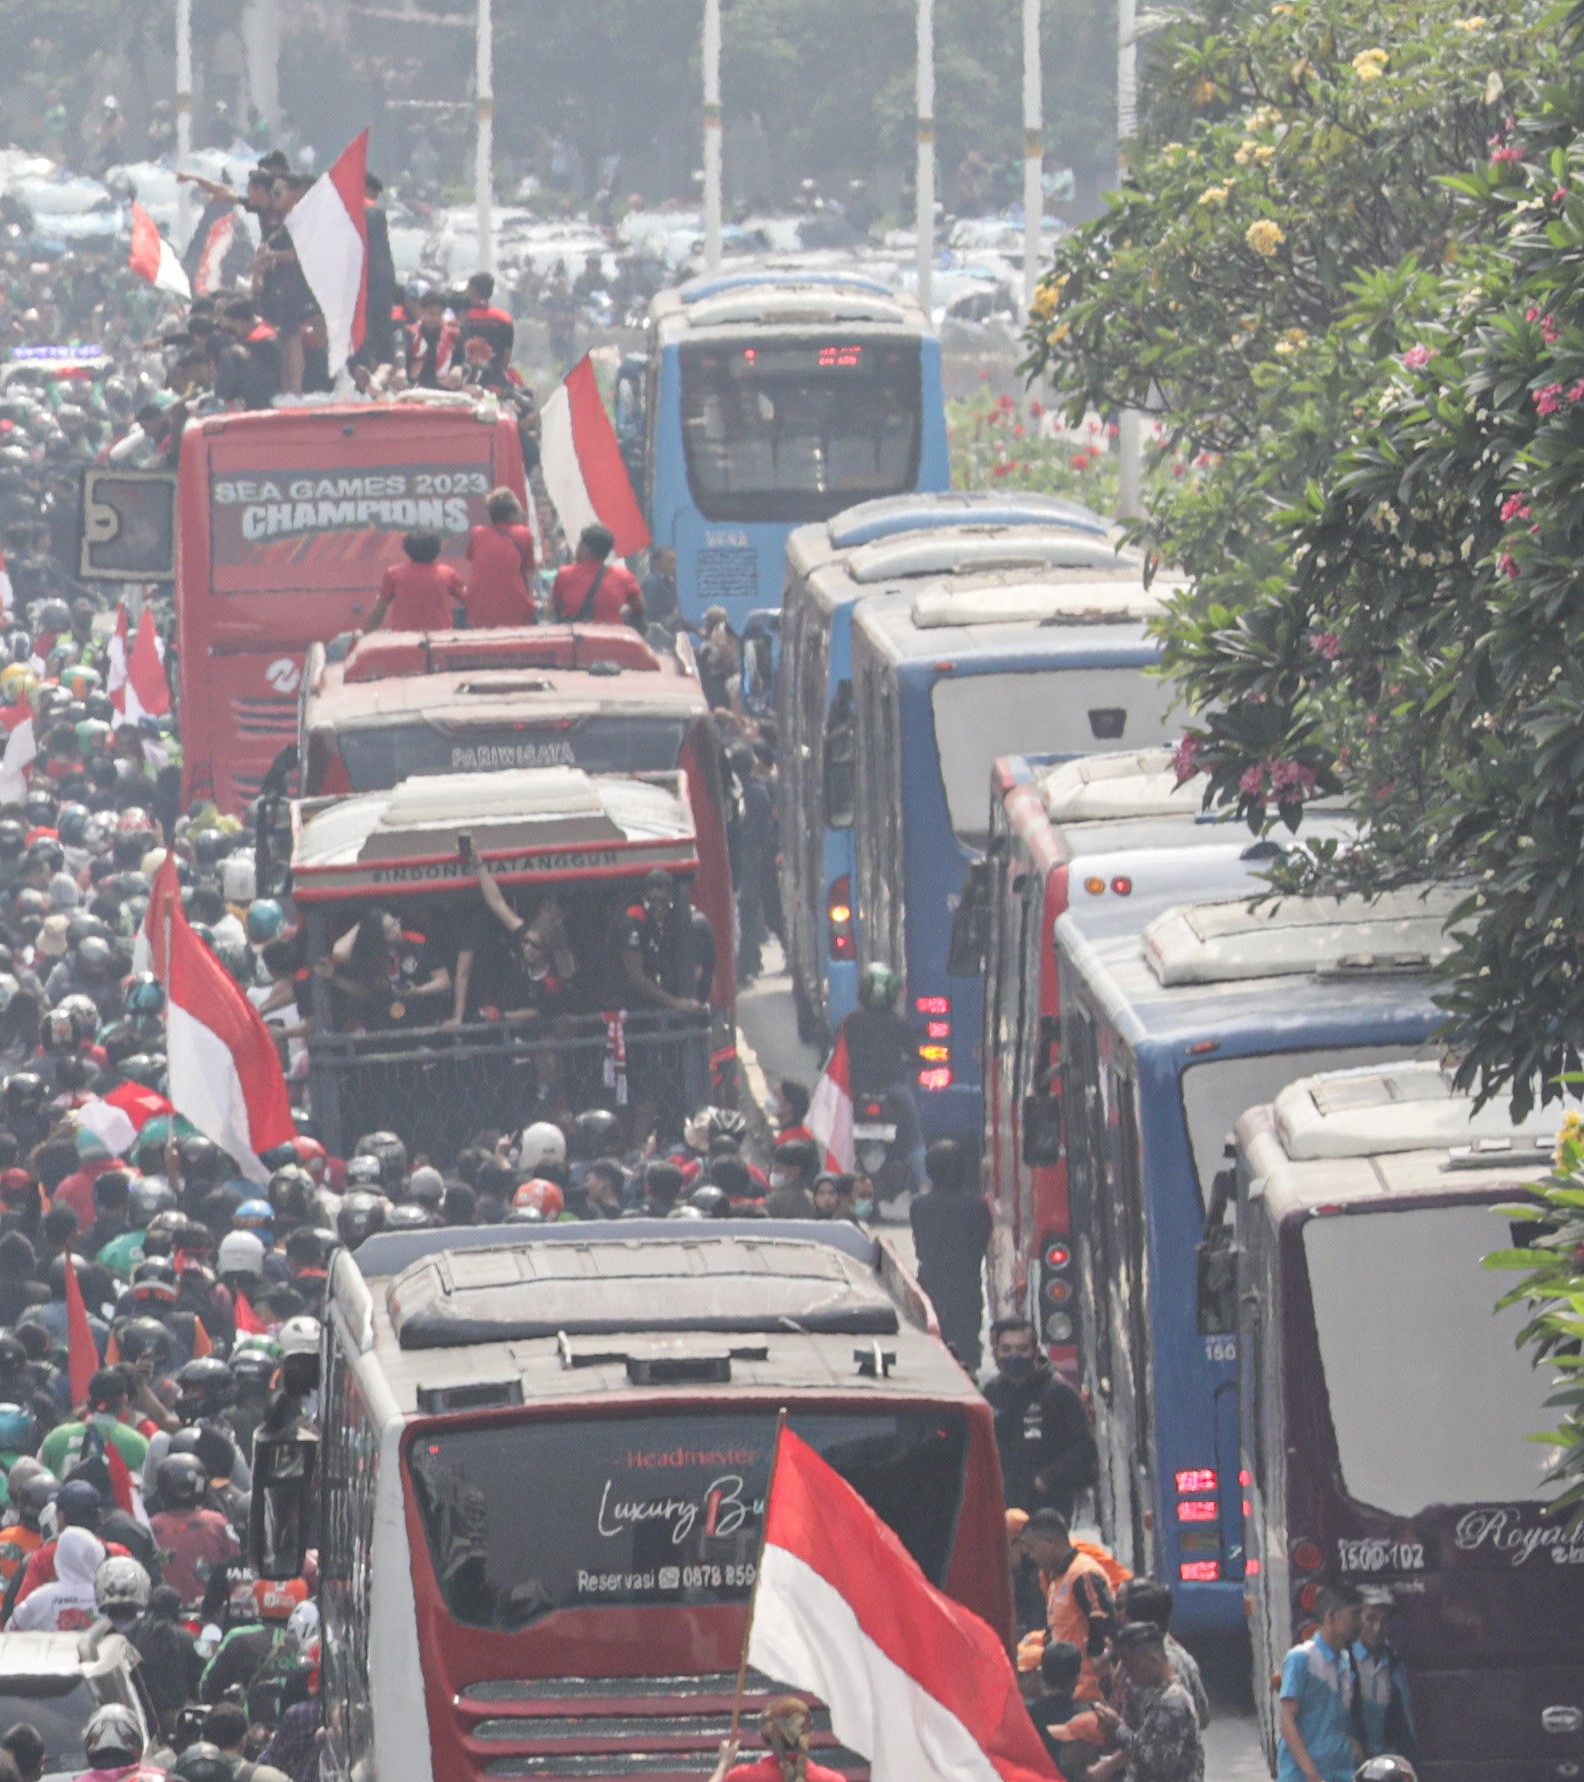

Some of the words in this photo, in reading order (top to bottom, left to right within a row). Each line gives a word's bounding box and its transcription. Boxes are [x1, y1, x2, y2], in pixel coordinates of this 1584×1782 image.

[214, 481, 282, 504] SEA
[289, 475, 407, 500] GAMES
[416, 471, 489, 495] 2023
[241, 498, 469, 543] CHAMPIONS
[451, 742, 576, 769] PARIWISATA
[598, 1477, 697, 1544] Luxury
[704, 1474, 765, 1538] Bu
[577, 1567, 655, 1593] Reservasi
[682, 1563, 723, 1588] 0878
